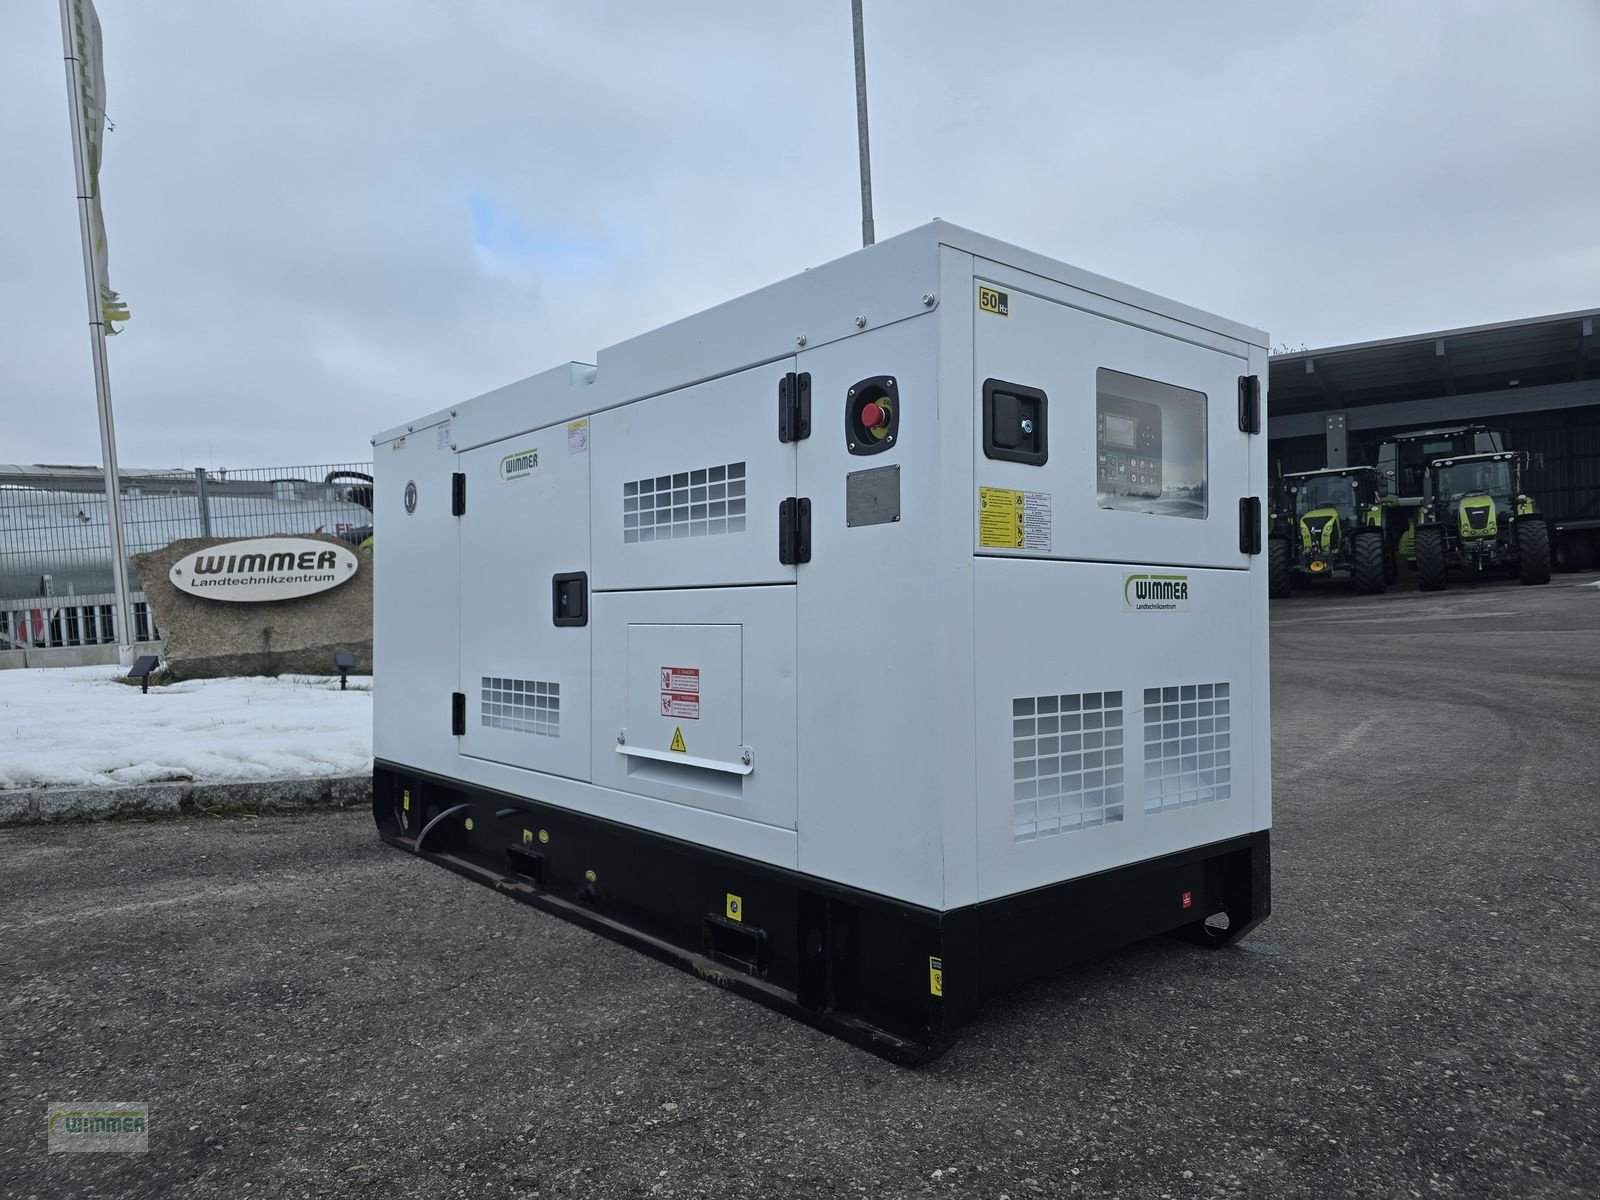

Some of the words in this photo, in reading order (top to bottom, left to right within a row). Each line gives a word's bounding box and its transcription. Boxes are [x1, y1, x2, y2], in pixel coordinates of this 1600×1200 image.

[982, 291, 997, 308] 50
[999, 304, 1008, 313] Hz
[505, 453, 538, 473] WIMMER
[194, 551, 337, 574] WIMMER
[191, 574, 335, 587] Landtechnikzentrum
[1135, 581, 1188, 600] WIMMER
